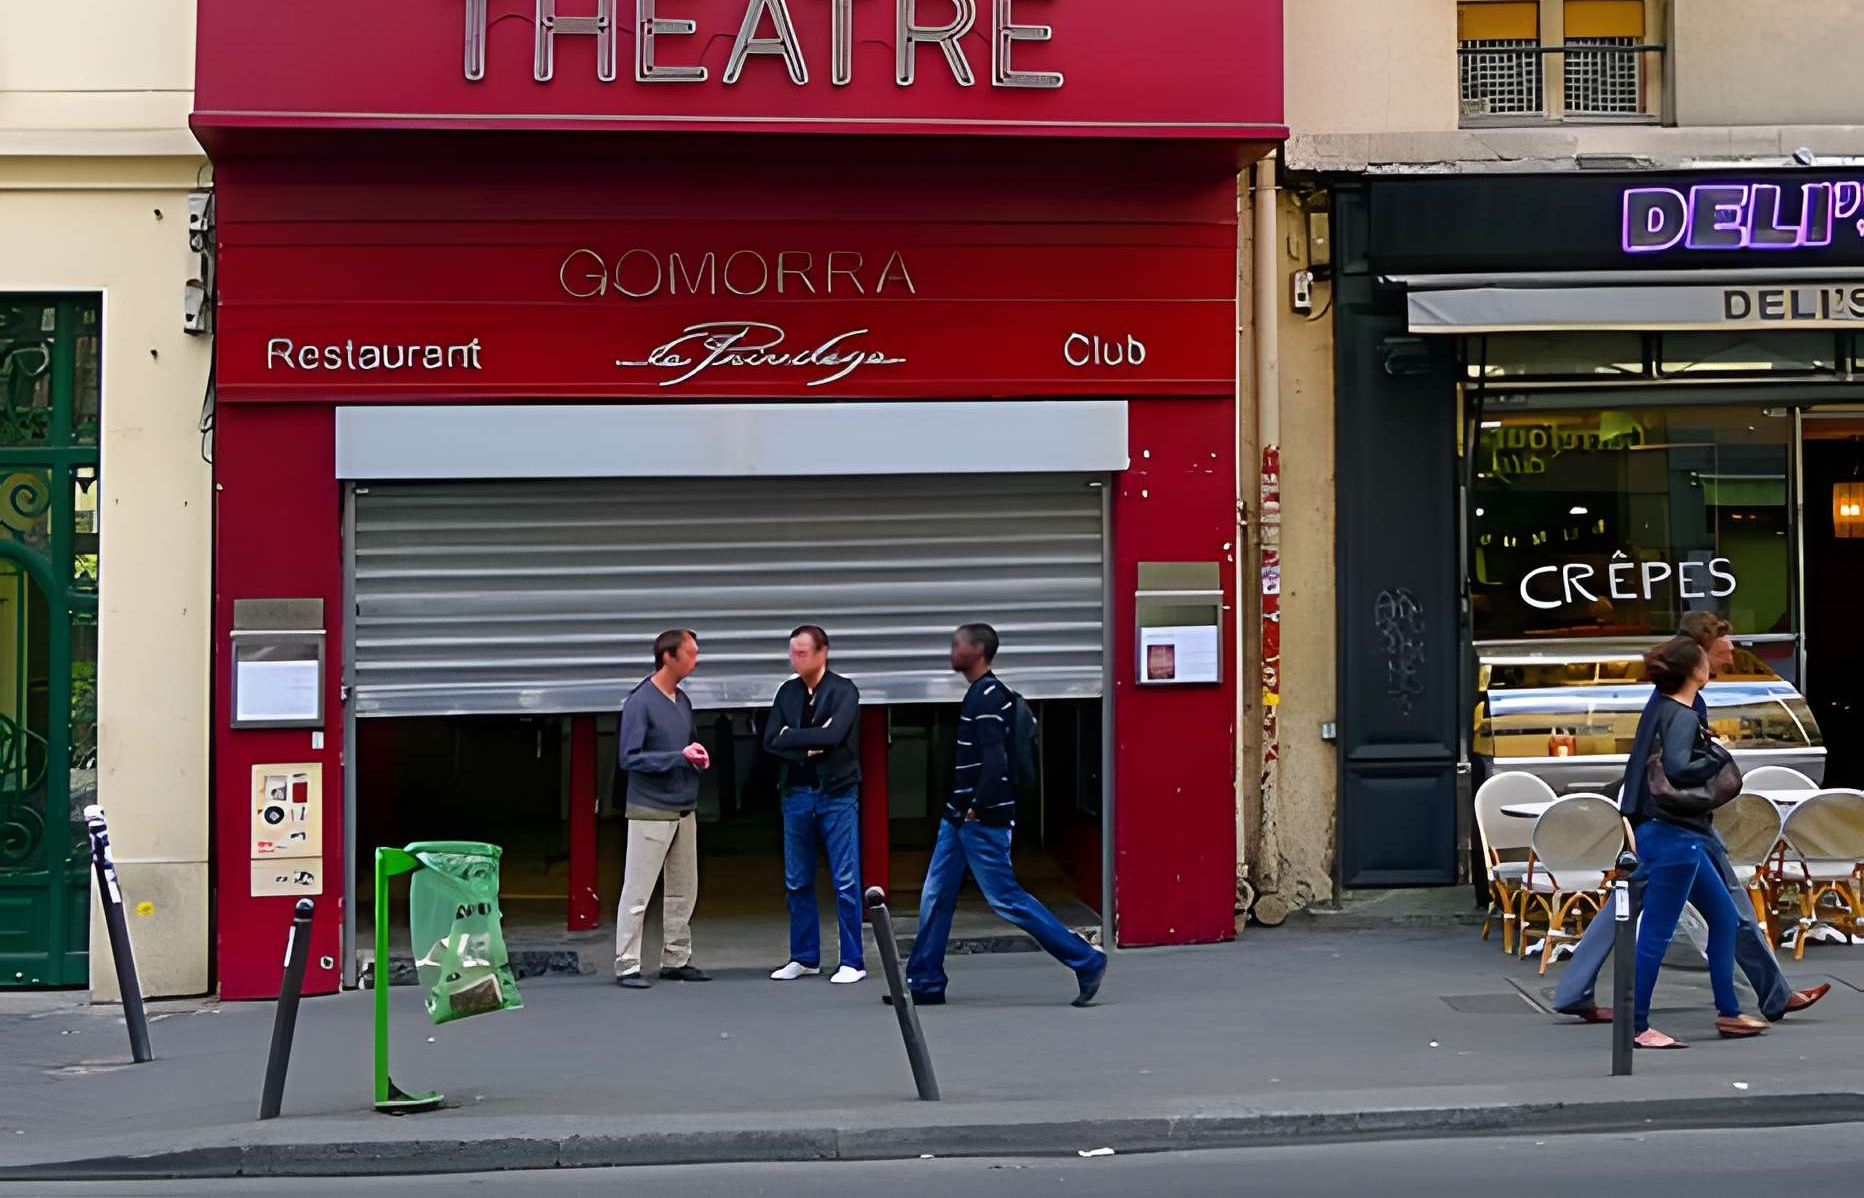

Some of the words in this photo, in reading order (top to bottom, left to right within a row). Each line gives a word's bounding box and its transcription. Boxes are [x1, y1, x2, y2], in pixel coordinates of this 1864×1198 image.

[560, 249, 916, 297] GOMORRA
[267, 337, 482, 370] Restaurant
[1064, 332, 1146, 366] Club
[1520, 549, 1737, 609] CRÊPES
